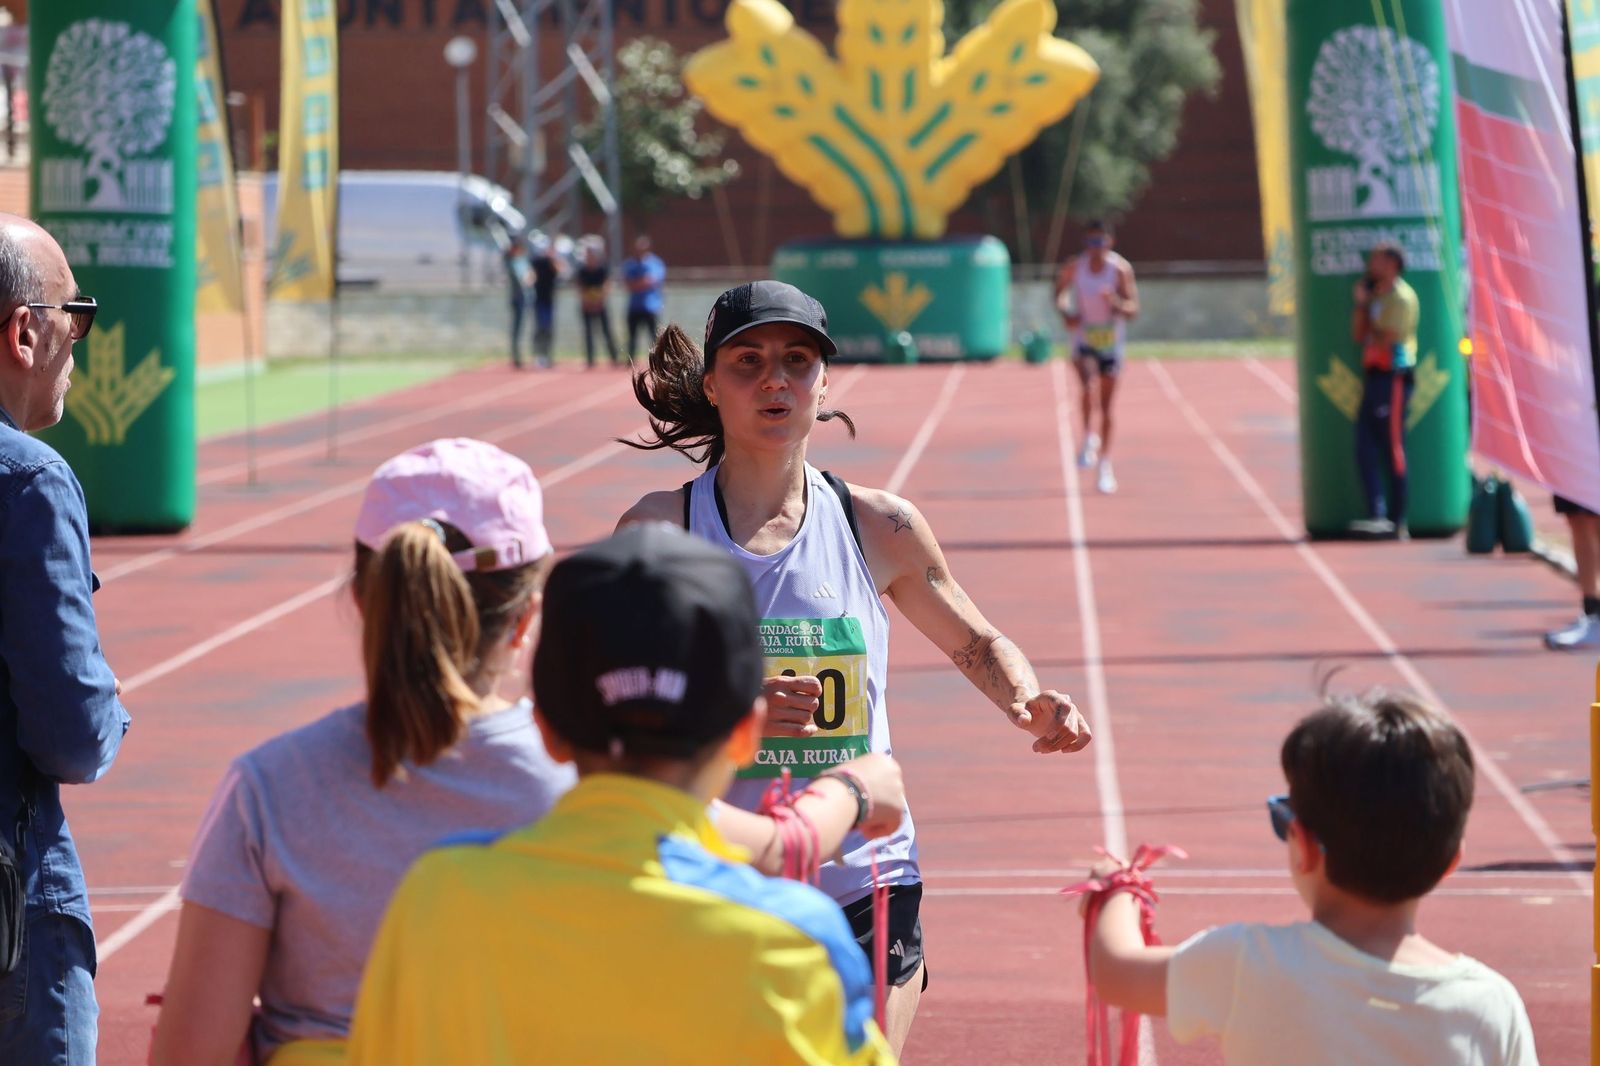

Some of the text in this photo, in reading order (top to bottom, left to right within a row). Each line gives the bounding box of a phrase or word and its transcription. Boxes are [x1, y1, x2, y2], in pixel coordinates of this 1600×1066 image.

[758, 624, 825, 636] UNDACION
[760, 635, 826, 647] AJA RURAL
[780, 668, 846, 731] 0
[754, 748, 799, 765] CAJA
